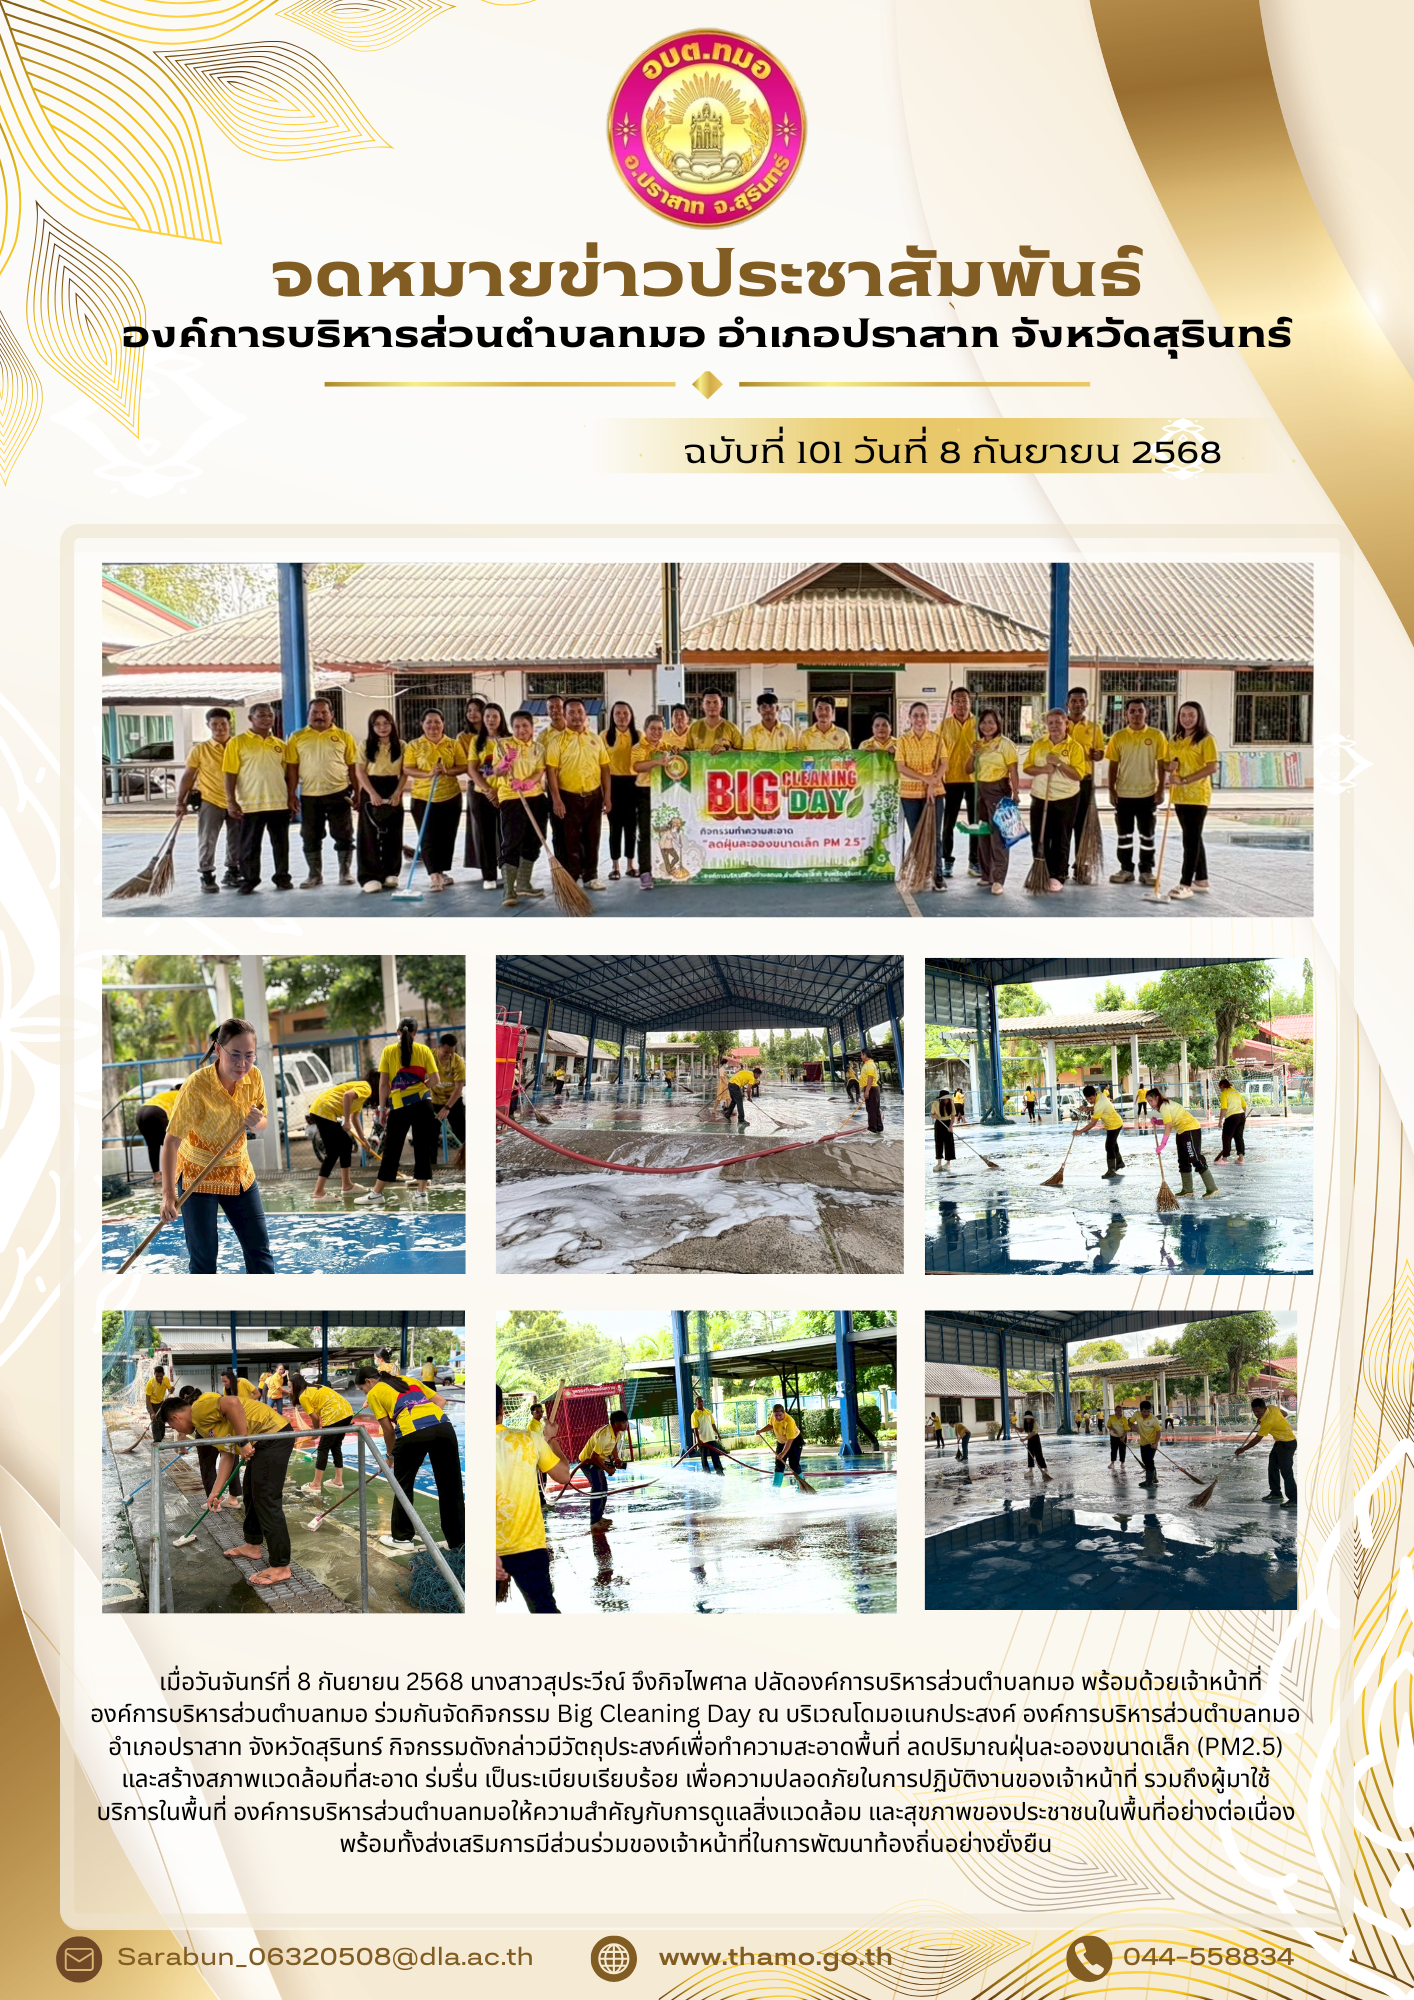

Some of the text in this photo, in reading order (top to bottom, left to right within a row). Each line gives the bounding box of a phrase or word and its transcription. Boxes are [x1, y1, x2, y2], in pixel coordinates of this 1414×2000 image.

[782, 769, 857, 788] CLEANING
[706, 769, 781, 818] BIG
[789, 788, 849, 815] DAY
[700, 826, 794, 836] กิจกรรมทำความสะอาด
[824, 838, 840, 847] PM
